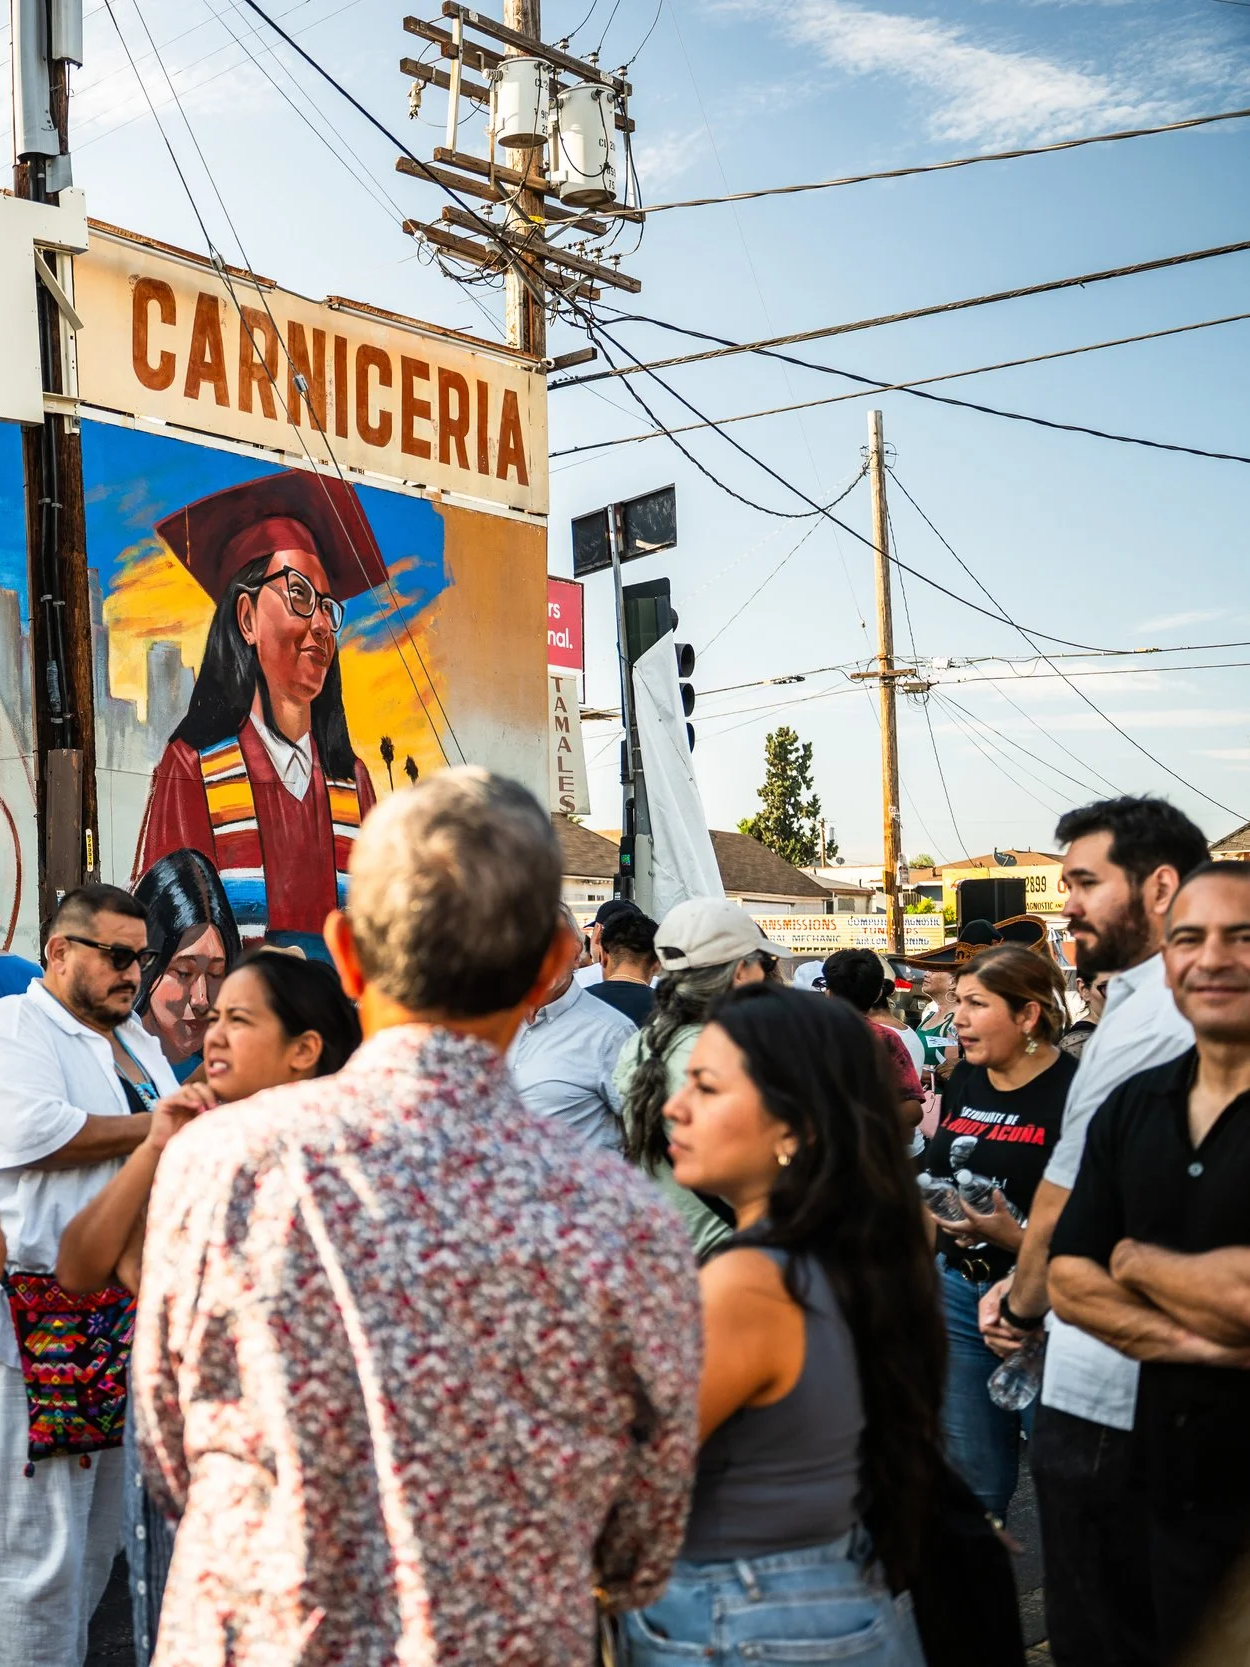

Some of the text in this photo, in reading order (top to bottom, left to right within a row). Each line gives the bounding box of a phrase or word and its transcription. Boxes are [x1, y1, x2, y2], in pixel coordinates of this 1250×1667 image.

[132, 277, 529, 487] CARNICERIA
[550, 676, 576, 815] TAMALES
[1025, 901, 1054, 911] AGNOSTIC
[904, 917, 941, 926] AGNOSTIC
[985, 1123, 1046, 1146] ACUÑA
